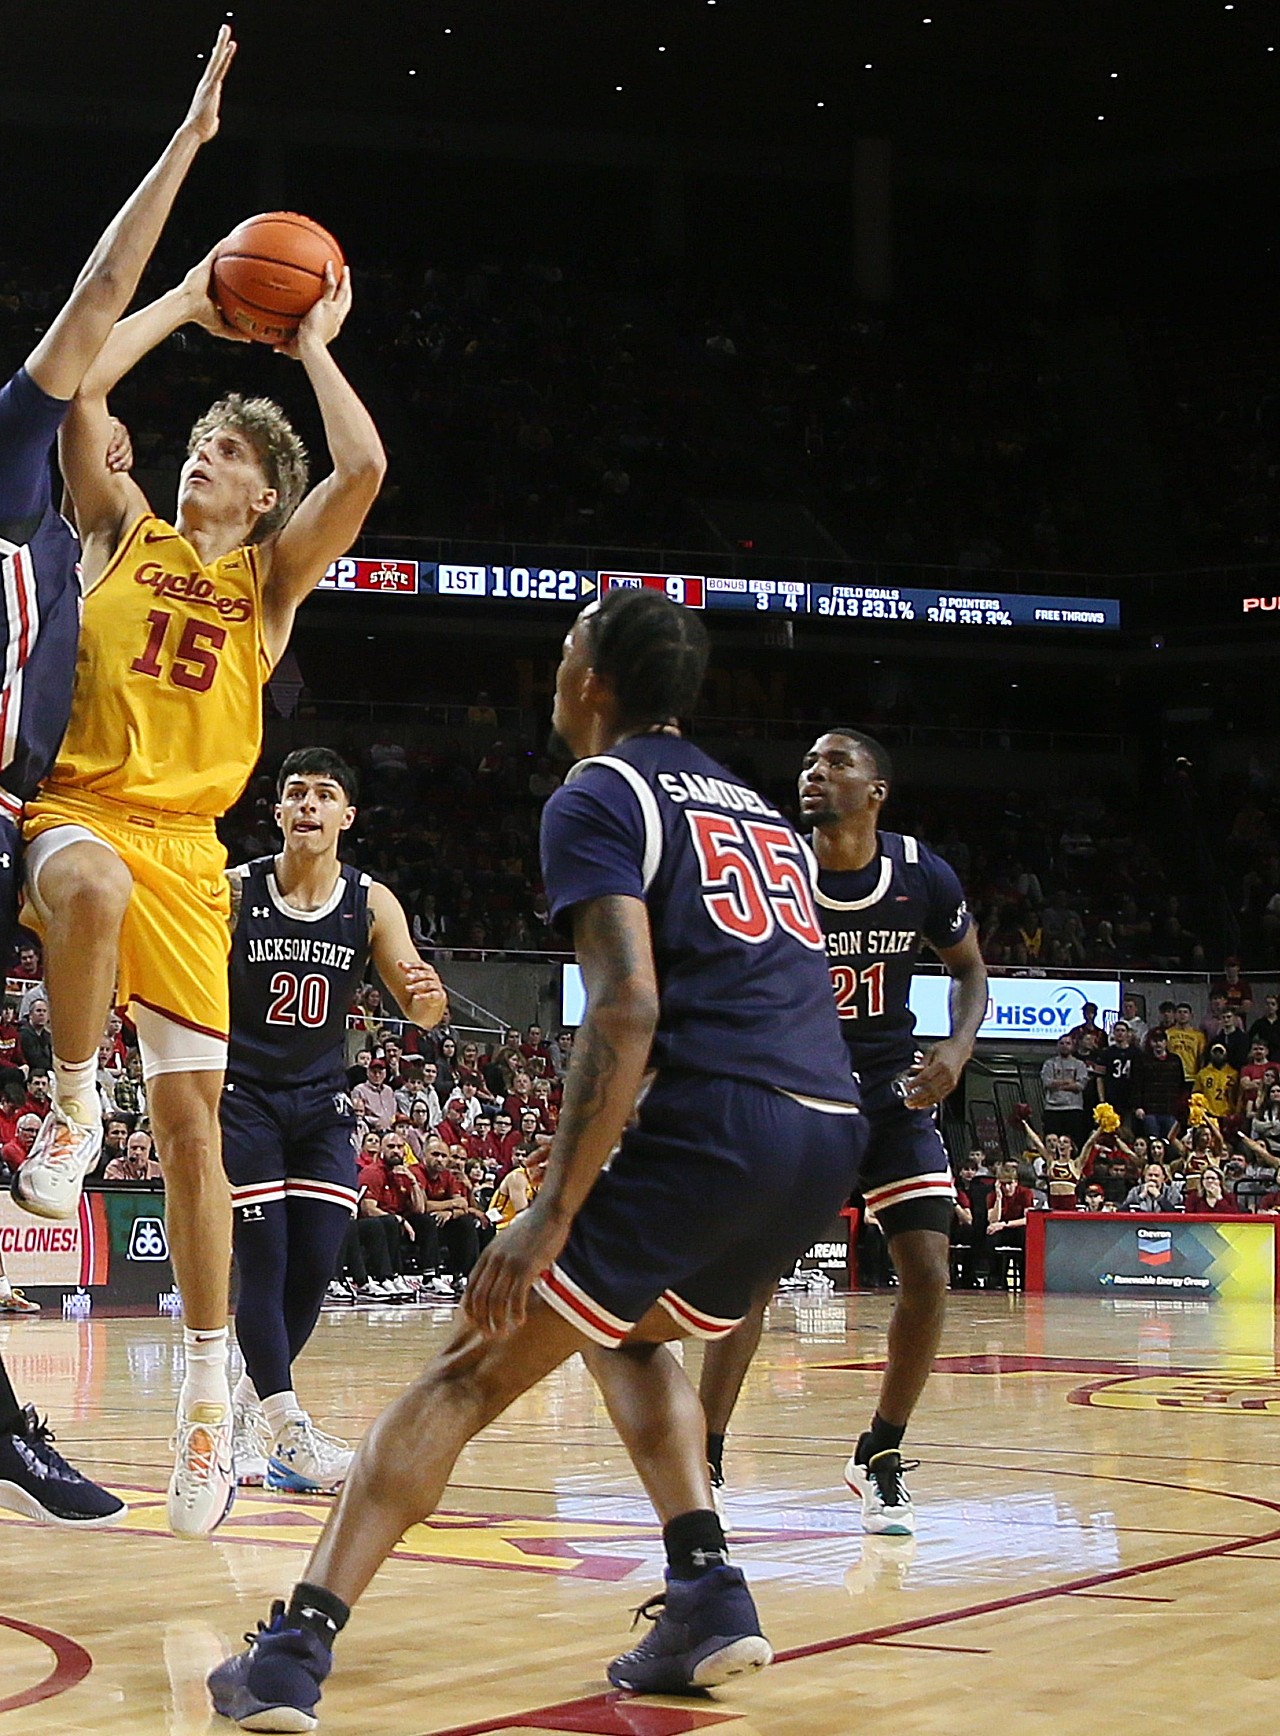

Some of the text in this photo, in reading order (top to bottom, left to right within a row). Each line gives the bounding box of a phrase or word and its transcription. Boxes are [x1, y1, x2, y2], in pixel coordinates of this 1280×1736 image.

[369, 570, 408, 585] STATE
[445, 570, 479, 590] 1ST
[491, 566, 577, 600] 10:22
[709, 579, 801, 593] BONUS FLS TOL
[134, 562, 252, 622] Cycloes
[665, 577, 684, 604] 9
[832, 586, 900, 601] FIELD GOALS
[756, 593, 798, 612] 3 4
[818, 596, 915, 620] 3/13 23.1%
[938, 597, 1000, 610] 3 POINTERS
[1243, 597, 1280, 613] PU
[1035, 609, 1105, 624] FREE THROWS
[131, 609, 227, 692] 15
[657, 771, 782, 818] SAMUEL
[683, 809, 826, 951] 55
[247, 938, 355, 971] JACKSON STATE
[824, 930, 916, 957] SON STATE
[265, 971, 330, 1029] 20
[828, 961, 885, 1020] 21
[996, 1005, 1072, 1027] HiSOY
[1112, 1059, 1132, 1079] 34
[1138, 1229, 1172, 1239] Chevron
[1114, 1275, 1156, 1285] Renewable
[1156, 1277, 1184, 1288] Energy
